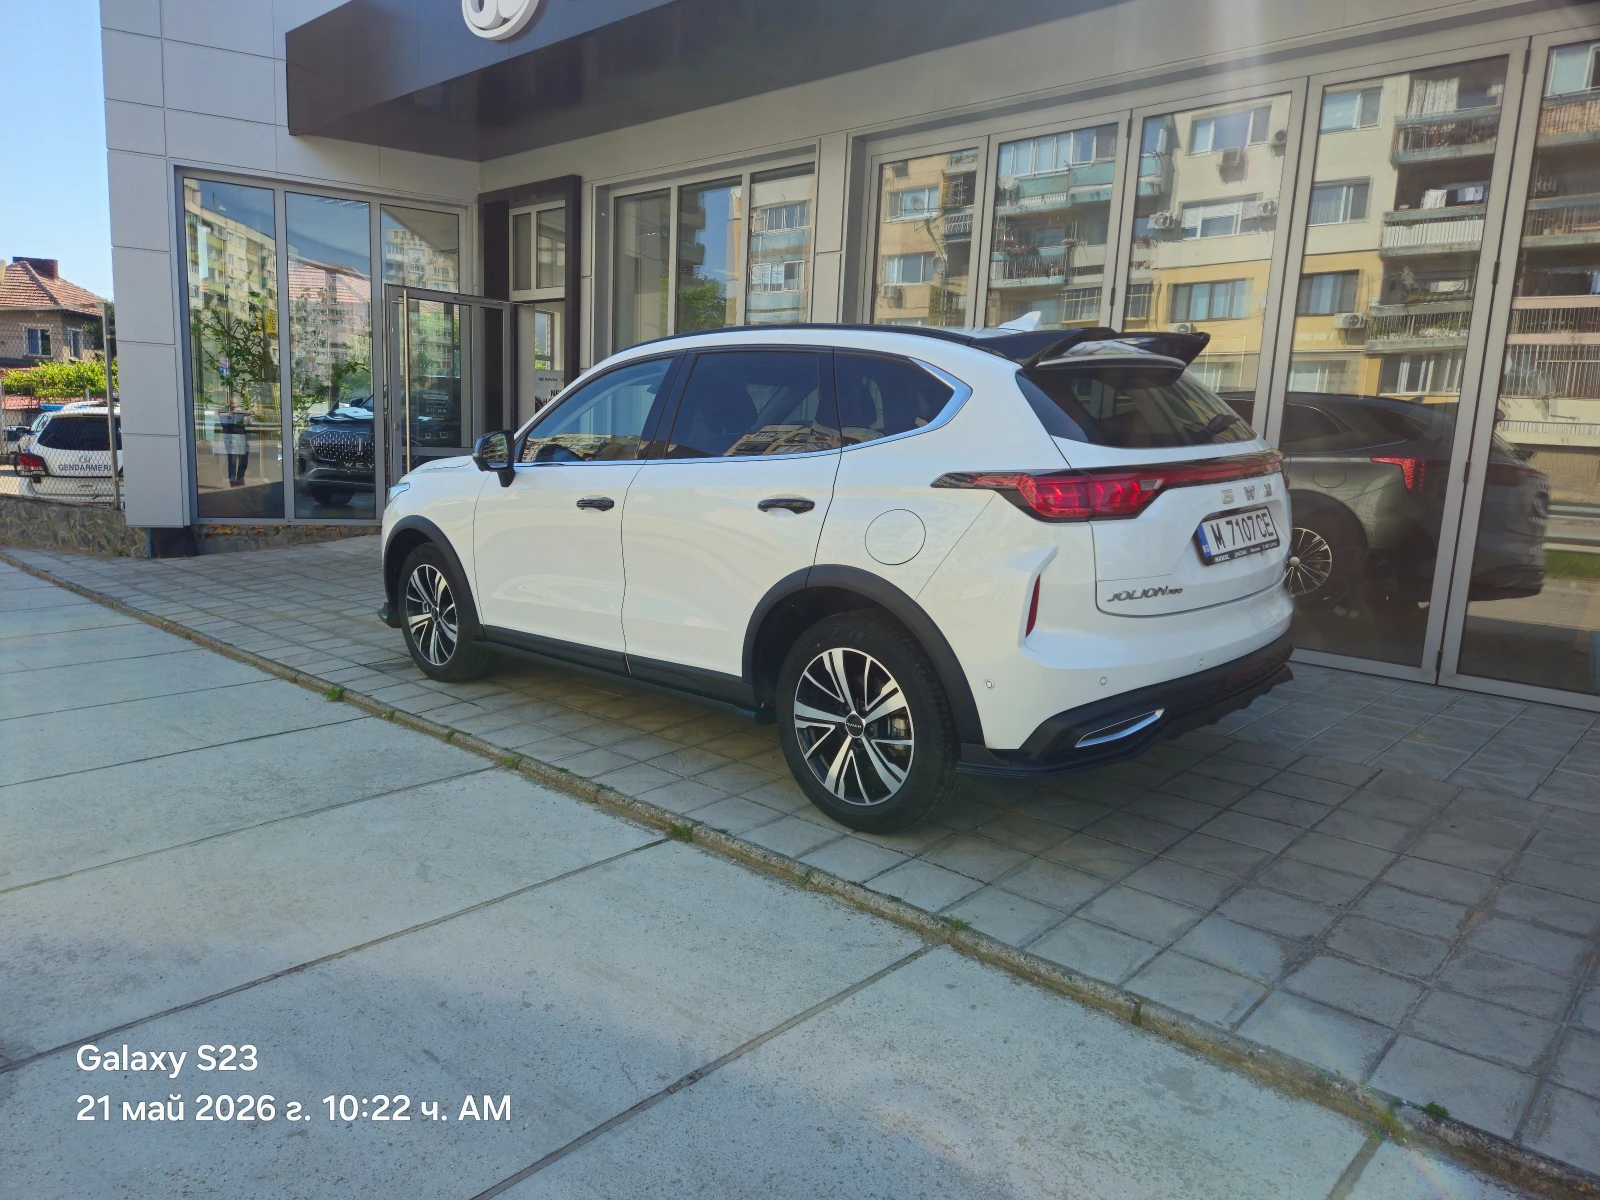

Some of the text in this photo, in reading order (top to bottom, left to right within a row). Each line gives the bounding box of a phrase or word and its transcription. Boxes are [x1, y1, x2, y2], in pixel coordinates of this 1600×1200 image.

[343, 461, 374, 469] WEY
[1222, 483, 1272, 503] GWM
[1210, 514, 1274, 550] M 7107 CE
[1106, 586, 1167, 602] JOLION
